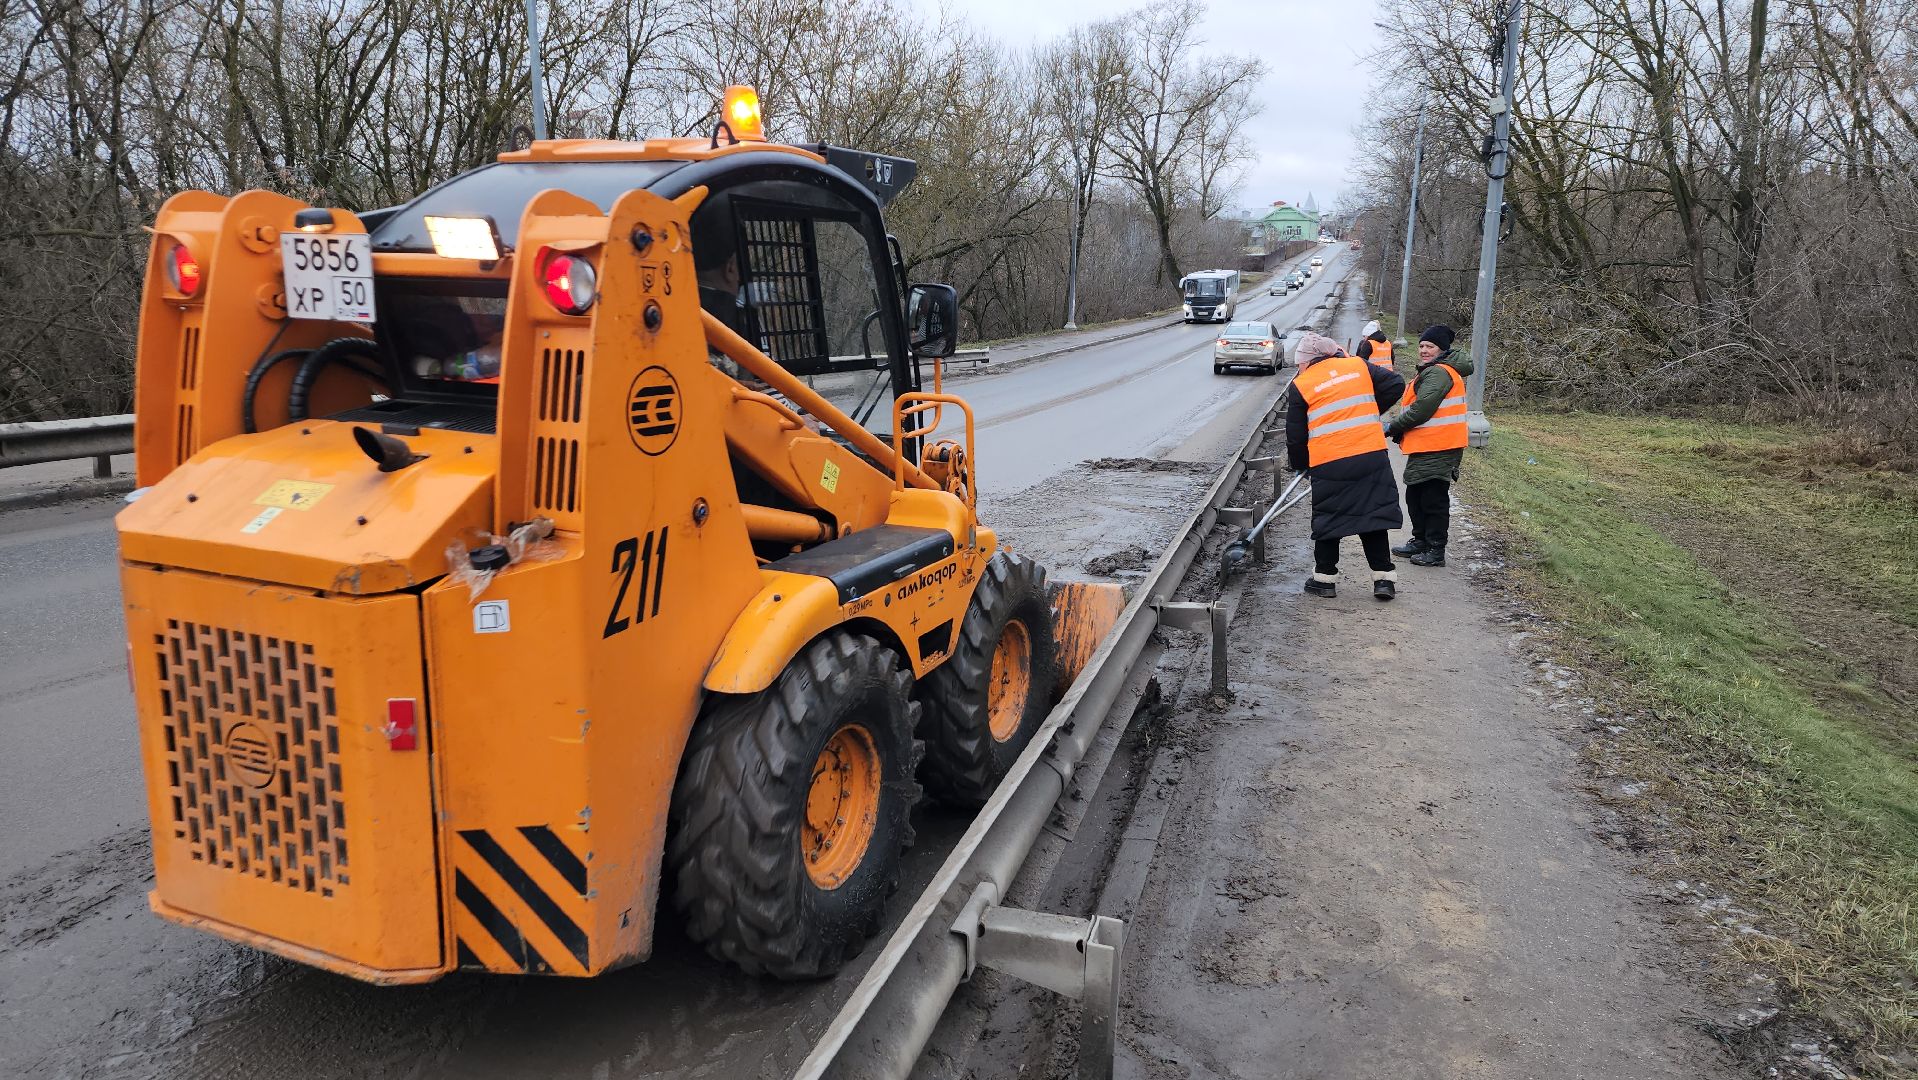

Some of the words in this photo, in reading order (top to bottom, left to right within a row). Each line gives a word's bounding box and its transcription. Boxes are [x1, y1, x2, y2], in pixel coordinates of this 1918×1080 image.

[293, 238, 359, 272] 5856
[293, 286, 324, 312] ХР
[341, 280, 366, 306] 50
[602, 525, 669, 640] 211
